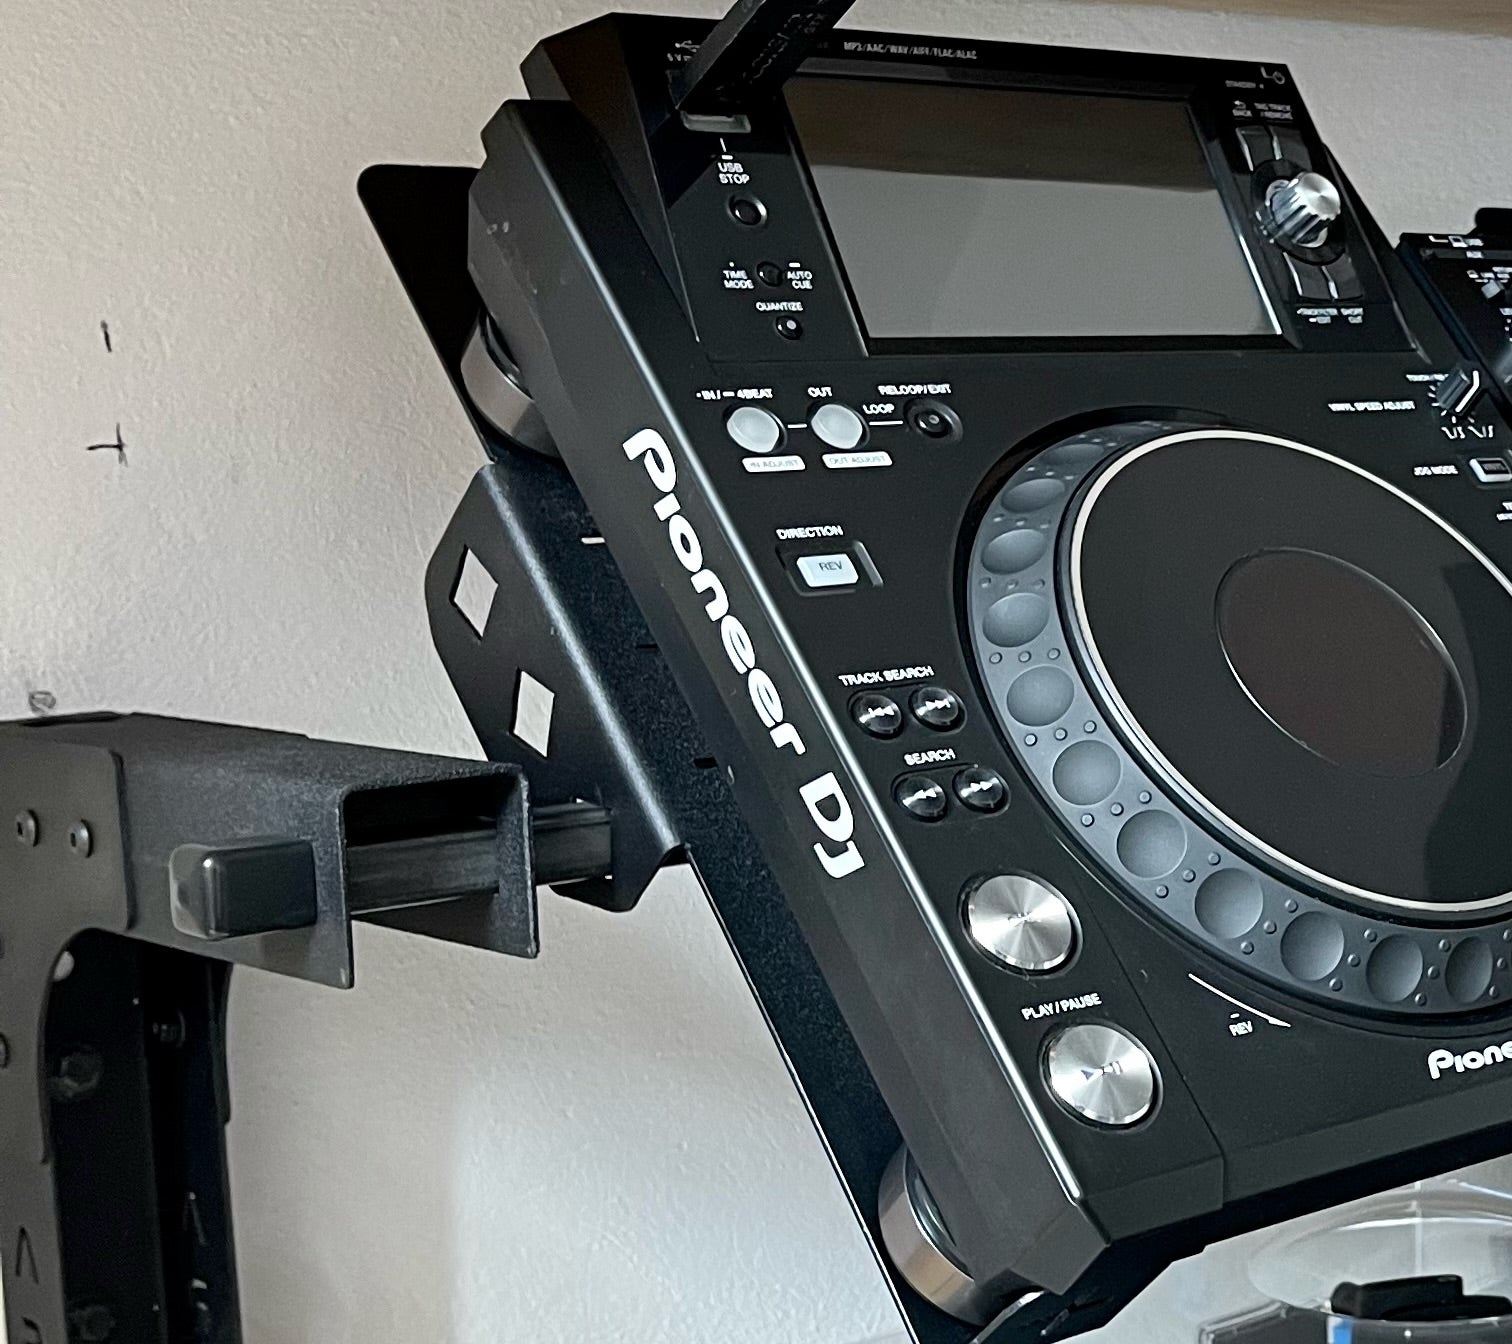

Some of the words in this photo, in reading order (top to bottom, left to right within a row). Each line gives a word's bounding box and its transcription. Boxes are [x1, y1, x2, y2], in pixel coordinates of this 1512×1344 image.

[717, 162, 744, 173] USB
[718, 173, 750, 184] STOP
[723, 270, 748, 280] TIME
[787, 270, 813, 280] AUTO
[723, 279, 755, 289] MODE
[791, 279, 813, 289] CUE
[755, 301, 804, 311] QUANTIZE
[807, 387, 833, 397] OUT
[862, 404, 895, 415] LOOP
[763, 459, 799, 469] ADJUST
[851, 455, 887, 465] ADJUST
[776, 525, 844, 539] DIRECTION
[818, 559, 844, 573] REV
[622, 428, 807, 756] Pioneer
[799, 770, 866, 870] DJ
[838, 670, 884, 687] TRACK
[882, 665, 935, 682] SEARCH
[903, 747, 957, 767] SEARCH
[1021, 992, 1102, 1021] PLAY/PAUSE
[1228, 1019, 1254, 1036] REV
